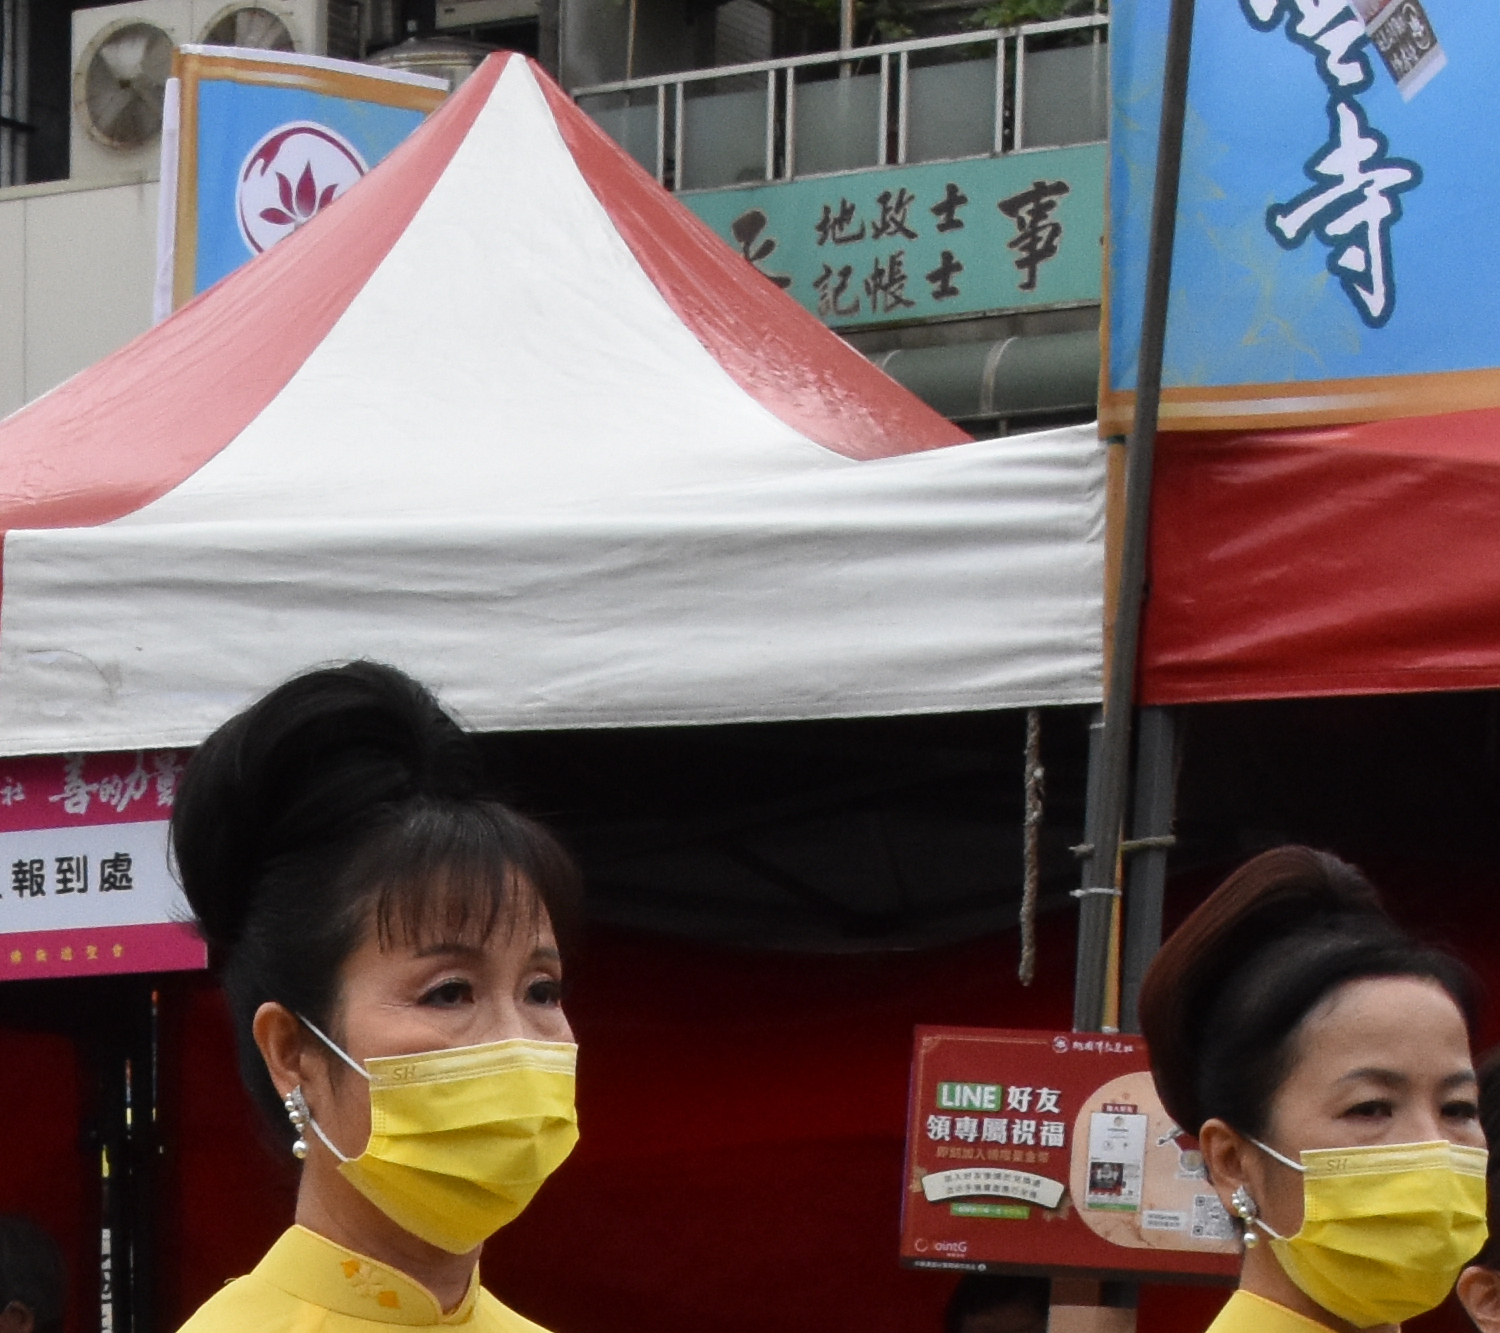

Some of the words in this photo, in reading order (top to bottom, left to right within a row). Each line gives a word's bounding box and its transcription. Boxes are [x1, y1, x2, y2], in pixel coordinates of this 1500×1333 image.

[815, 182, 969, 248] 地政士
[813, 250, 964, 317] 記帳士
[941, 1083, 997, 1109] LINE
[1007, 1086, 1062, 1114] 好友
